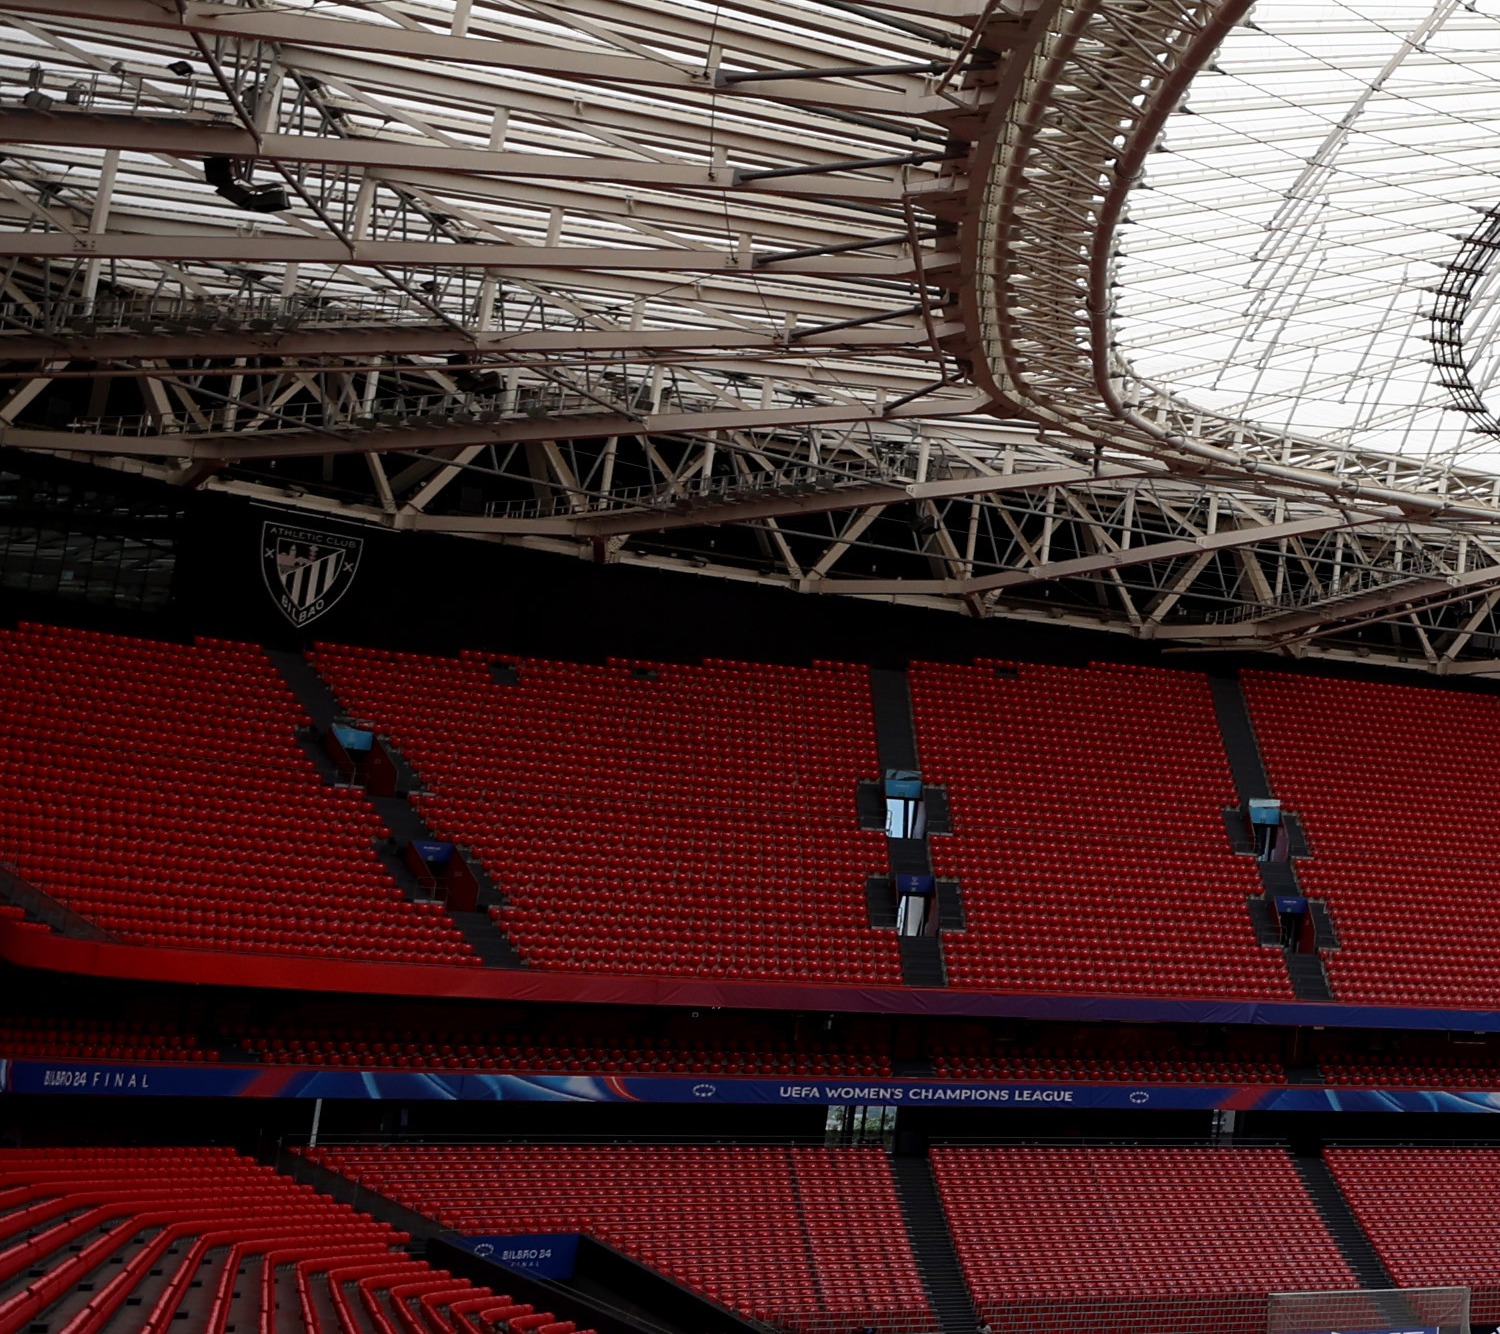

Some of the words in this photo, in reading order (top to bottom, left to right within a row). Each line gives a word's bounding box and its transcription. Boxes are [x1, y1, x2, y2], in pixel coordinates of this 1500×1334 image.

[270, 527, 323, 543] ATHLETIC
[326, 537, 356, 548] CLUB
[281, 594, 324, 623] BILBAO
[92, 1072, 149, 1088] FINAL
[780, 1086, 820, 1097] UEFA
[825, 1087, 903, 1099] WOMEN'S
[908, 1088, 1009, 1101] CHAMPIONS
[1014, 1090, 1073, 1102] LEAGUE
[502, 1249, 538, 1260] BILBAO
[539, 1249, 552, 1259] 24
